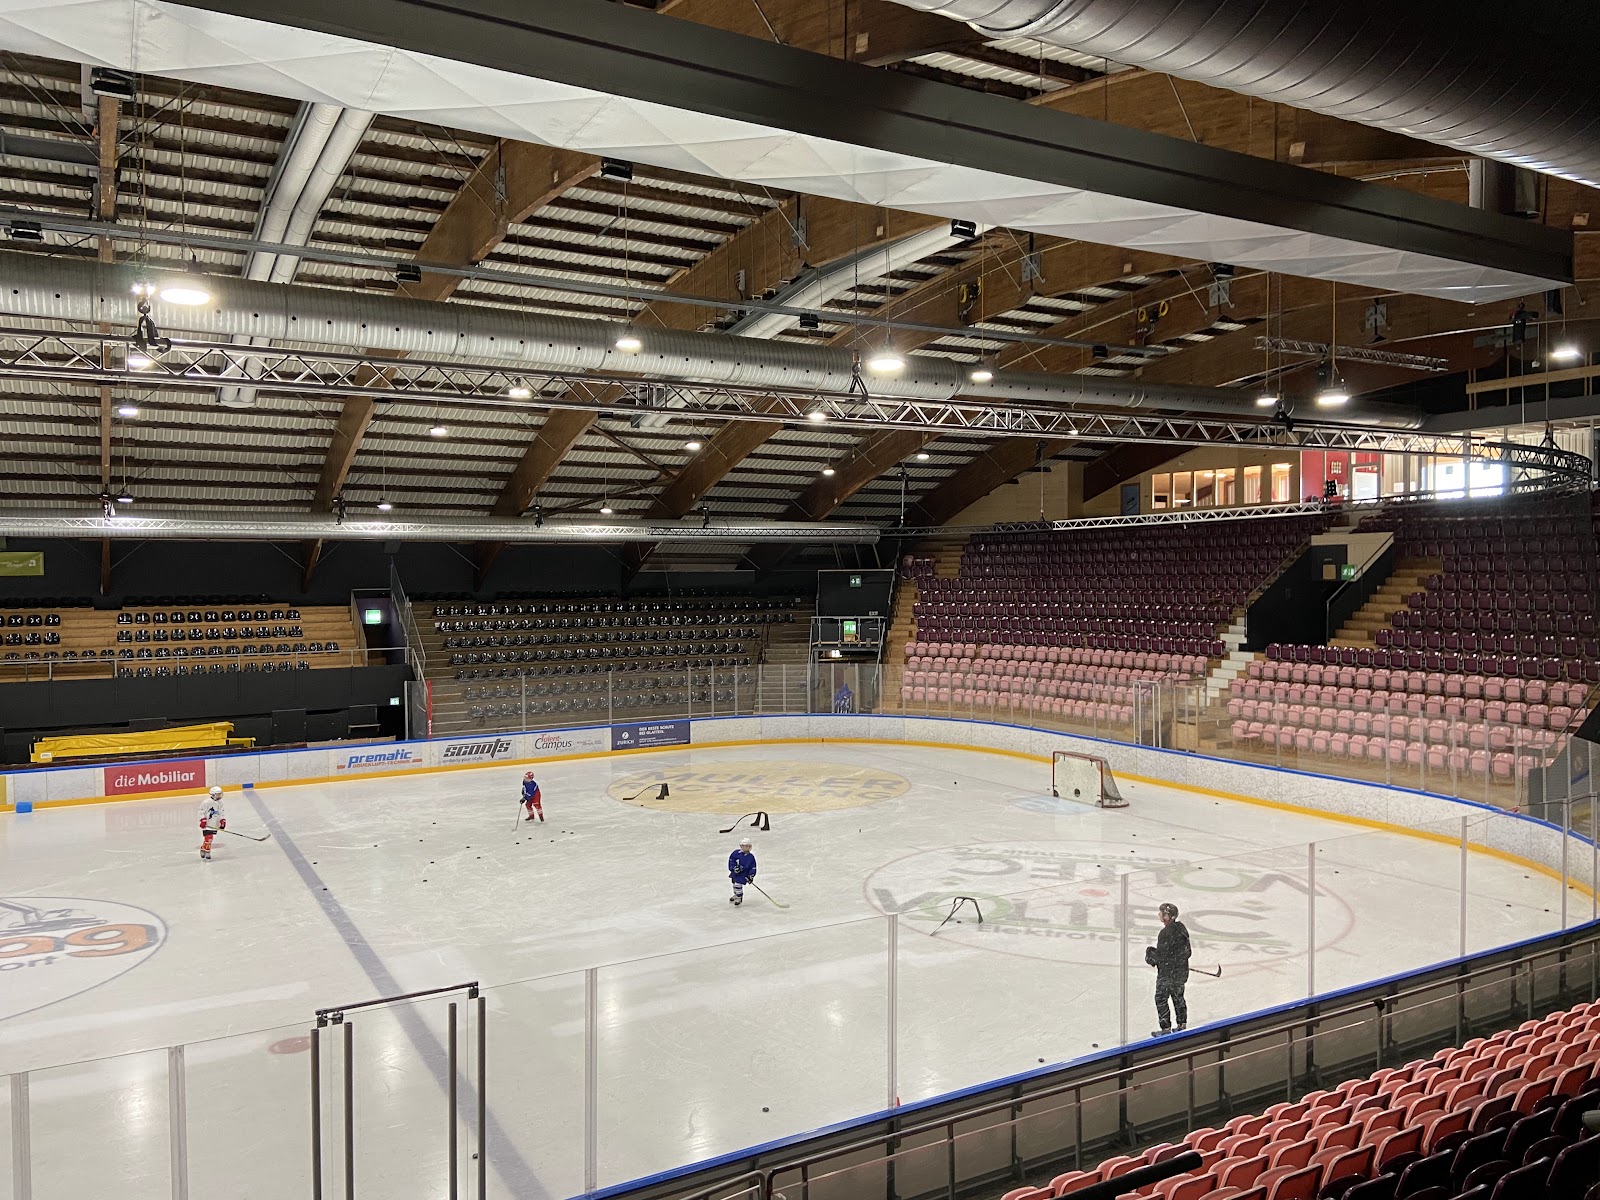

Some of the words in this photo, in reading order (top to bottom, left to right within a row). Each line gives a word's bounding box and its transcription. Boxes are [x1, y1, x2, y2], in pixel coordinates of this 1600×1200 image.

[534, 737, 573, 750] Campus
[347, 748, 413, 768] prematic
[114, 774, 136, 788] die
[137, 770, 196, 786] Mobiliar
[1231, 943, 1290, 956] AG
